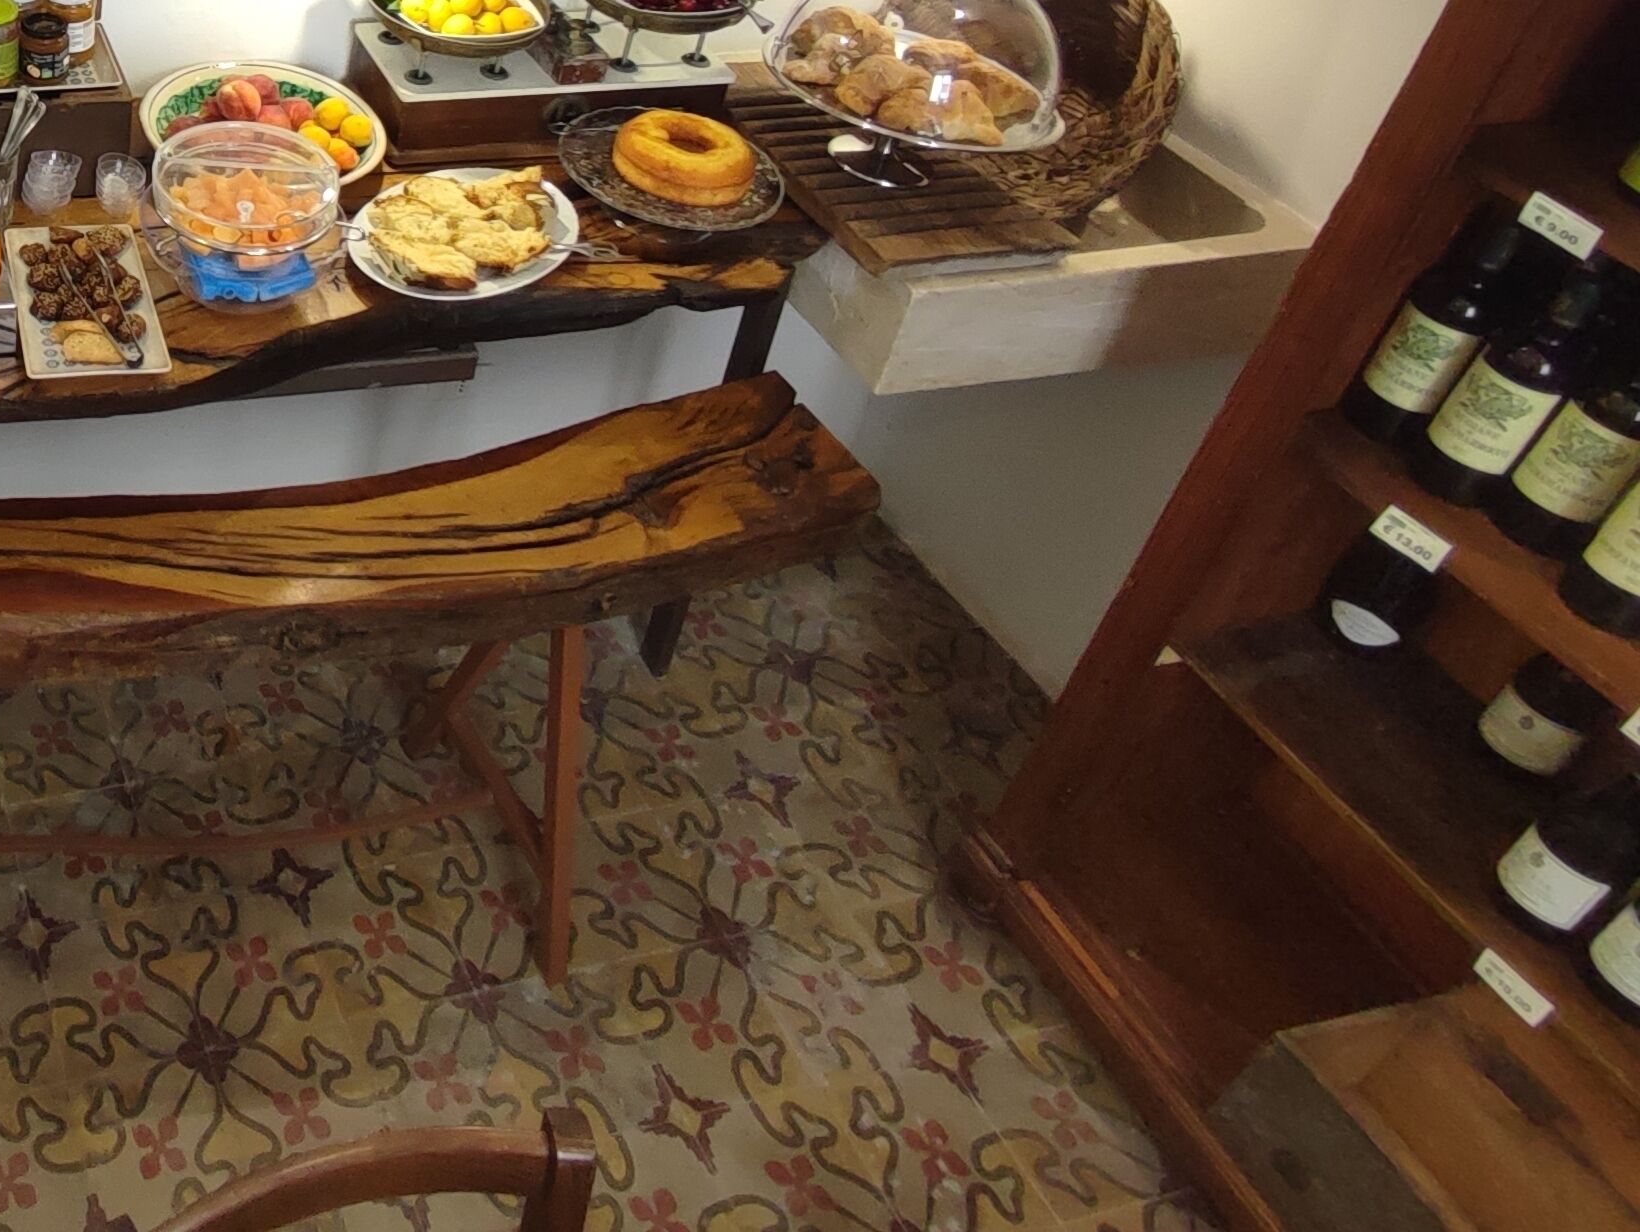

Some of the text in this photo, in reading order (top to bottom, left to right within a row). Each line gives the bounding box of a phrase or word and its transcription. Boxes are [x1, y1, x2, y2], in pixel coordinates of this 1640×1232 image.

[1534, 215, 1579, 245] € 9.00
[1382, 523, 1433, 561] € 13.00
